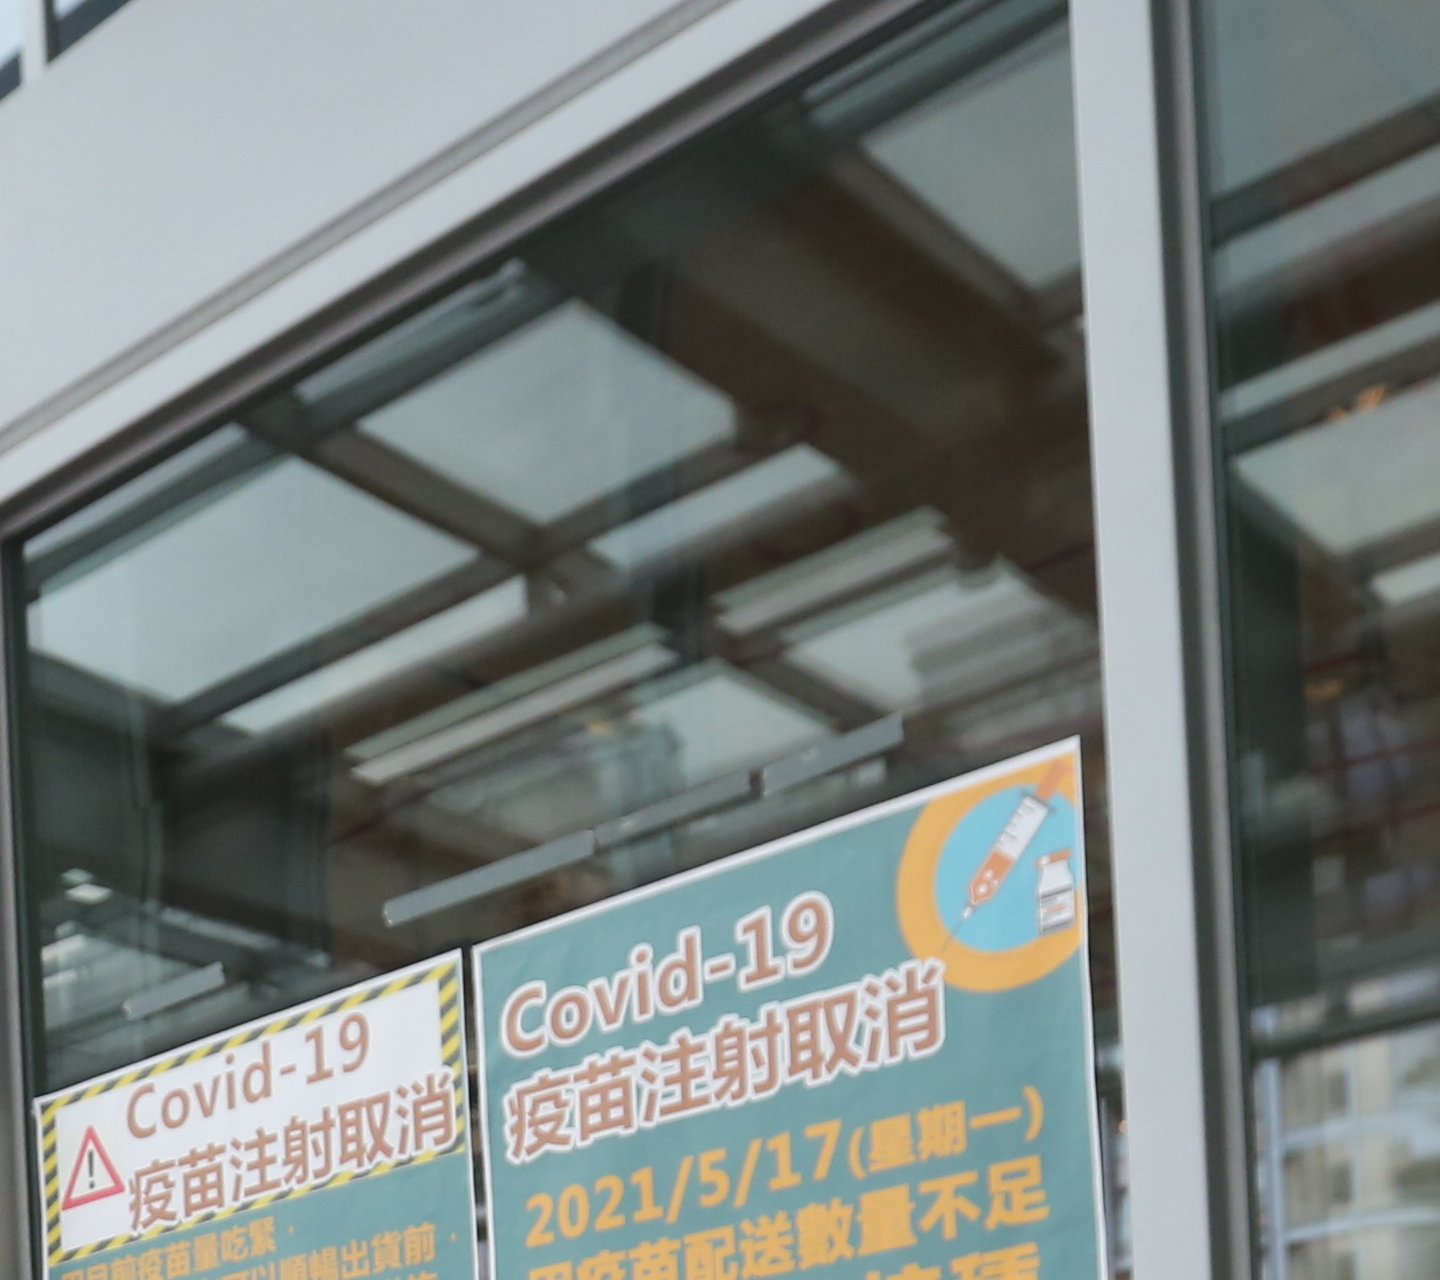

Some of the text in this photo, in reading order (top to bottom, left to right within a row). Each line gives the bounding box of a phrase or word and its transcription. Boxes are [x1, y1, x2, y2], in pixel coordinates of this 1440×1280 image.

[502, 892, 832, 1055] Covid-19
[127, 1012, 370, 1138] Covid-19
[504, 958, 946, 1164] 疫苗注射取消
[129, 1072, 454, 1230] 疫苗注射取消
[524, 1087, 1044, 1247] 2021/5/17(星期一)
